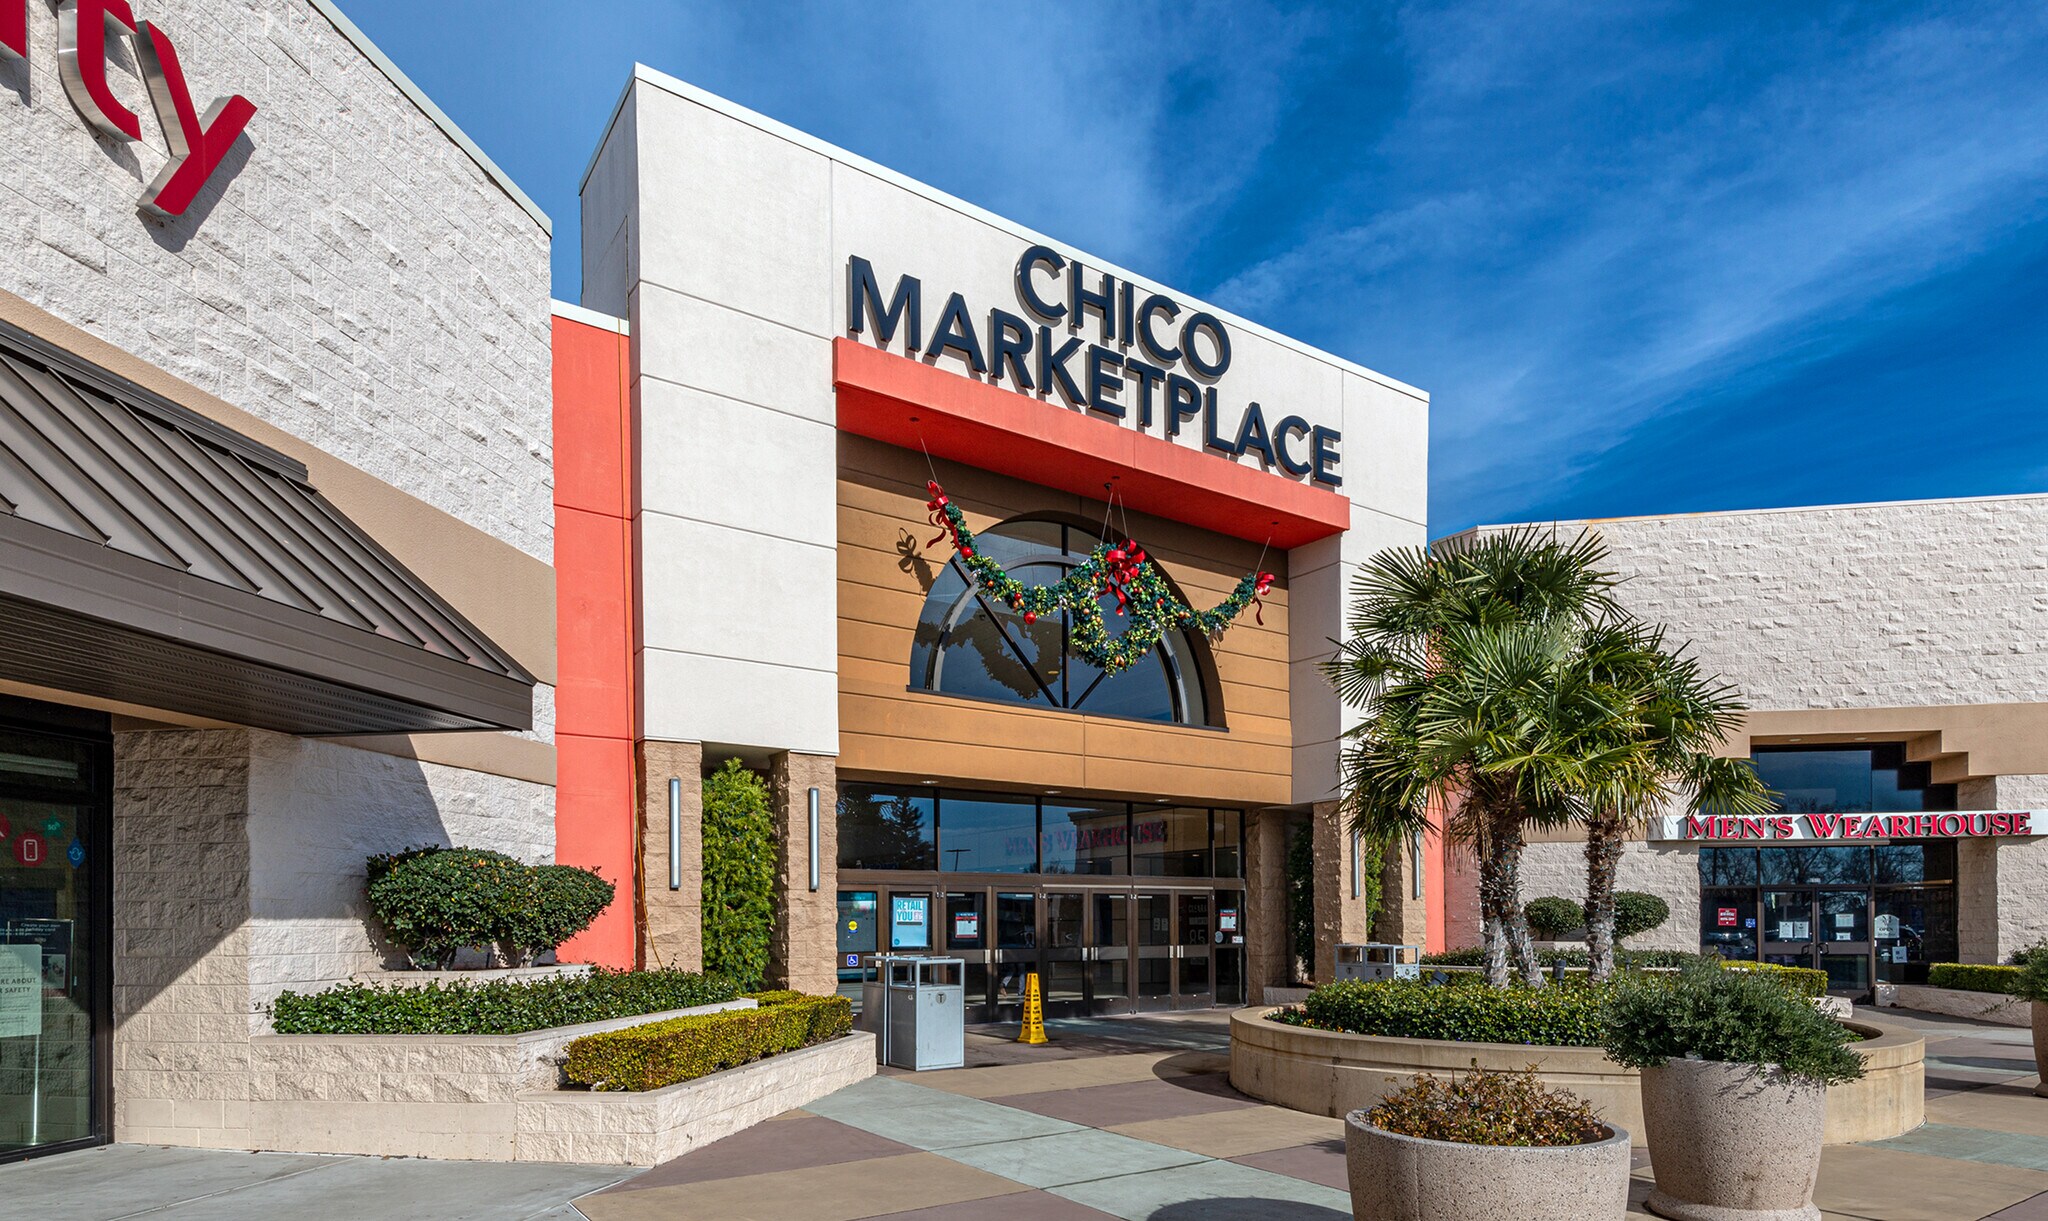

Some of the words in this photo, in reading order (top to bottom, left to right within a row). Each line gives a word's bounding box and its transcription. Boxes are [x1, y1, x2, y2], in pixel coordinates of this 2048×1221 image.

[0, 0, 258, 216] ty
[1015, 245, 1232, 377] CHICO
[848, 254, 1342, 487] MARKETPLACE
[1686, 814, 1794, 839] MEN'S
[1805, 812, 2032, 839] WEARHOUSE
[896, 900, 922, 910] RETAIL
[897, 911, 913, 921] YOU
[11, 977, 37, 985] ABOUT
